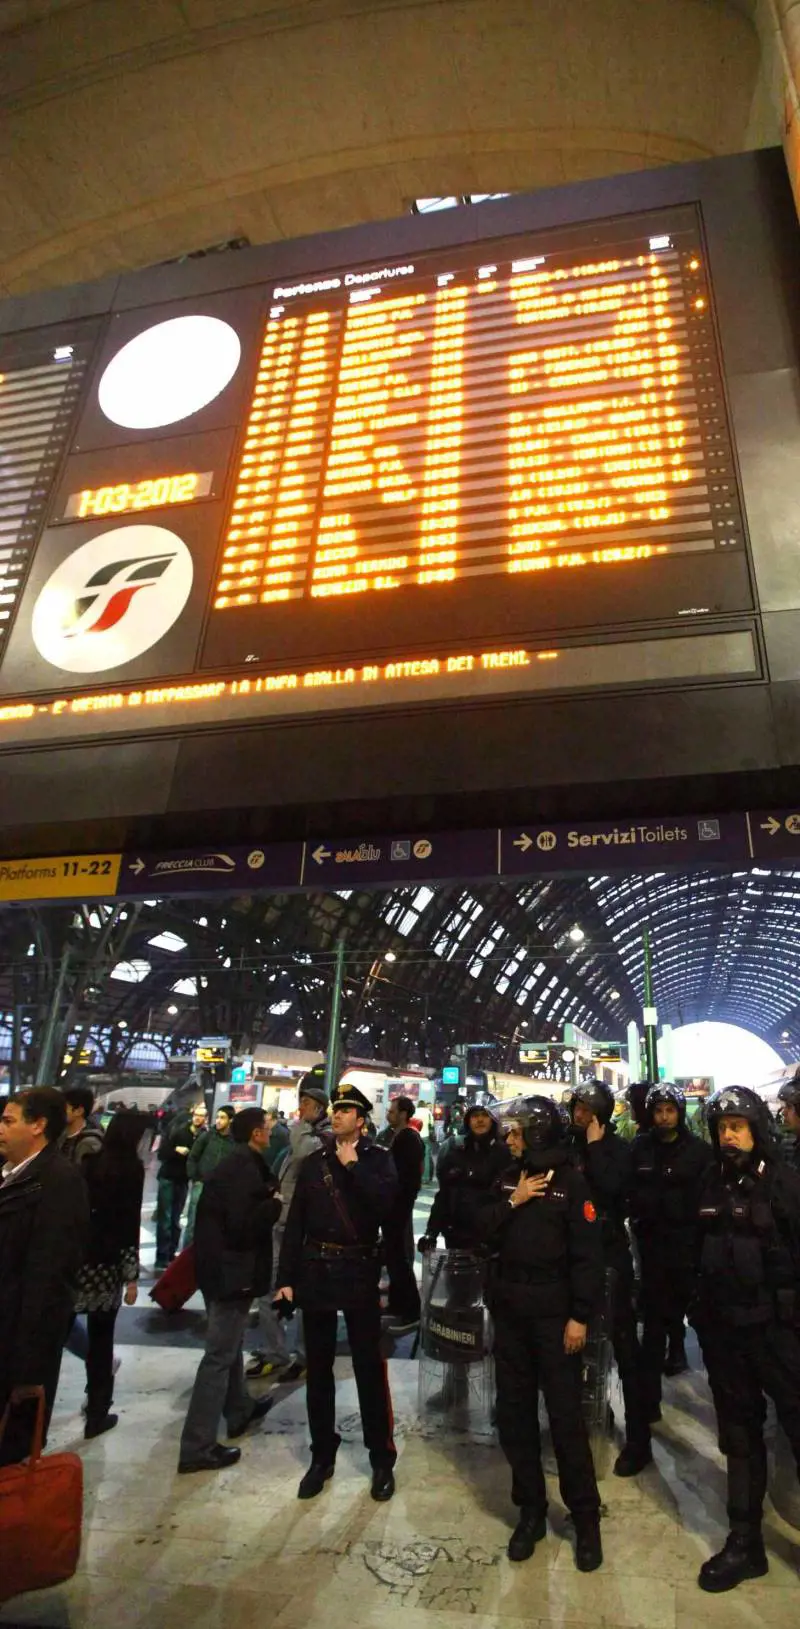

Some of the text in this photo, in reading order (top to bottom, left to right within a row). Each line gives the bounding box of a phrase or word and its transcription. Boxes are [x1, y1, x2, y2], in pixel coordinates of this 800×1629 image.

[273, 278, 341, 299] Partenze
[344, 265, 414, 286] Departures
[385, 659, 439, 679] ATTESA
[447, 655, 474, 672] DEI
[567, 825, 687, 848] Servizi Toilets
[0, 860, 112, 881] Platforms 11-22
[429, 1318, 476, 1345] CARABINIERI
